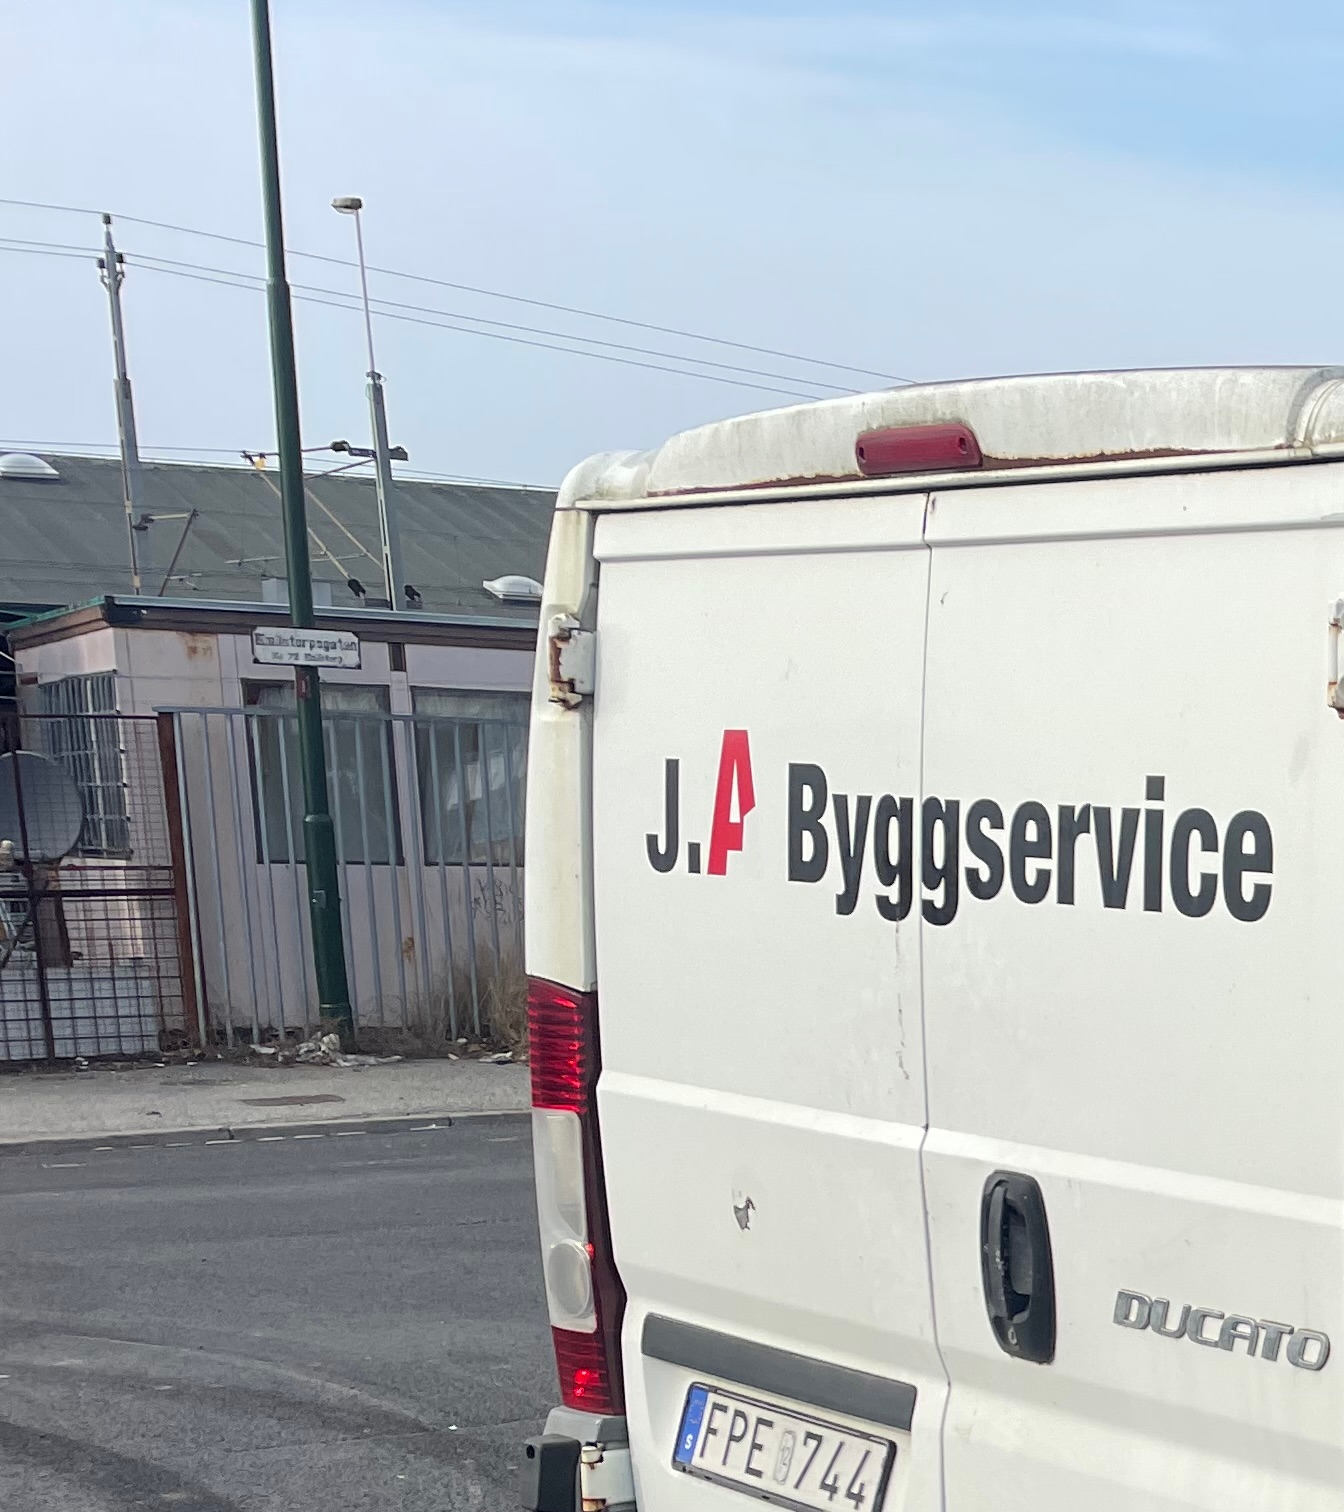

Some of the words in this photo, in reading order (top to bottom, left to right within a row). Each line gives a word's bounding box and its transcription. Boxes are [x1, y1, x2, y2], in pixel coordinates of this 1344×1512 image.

[645, 729, 756, 876] J.A
[787, 762, 1274, 927] Byggservice
[1112, 1288, 1331, 1371] DUCATO
[684, 1433, 693, 1450] S
[699, 1401, 774, 1478] FPE
[793, 1430, 872, 1510] 744
